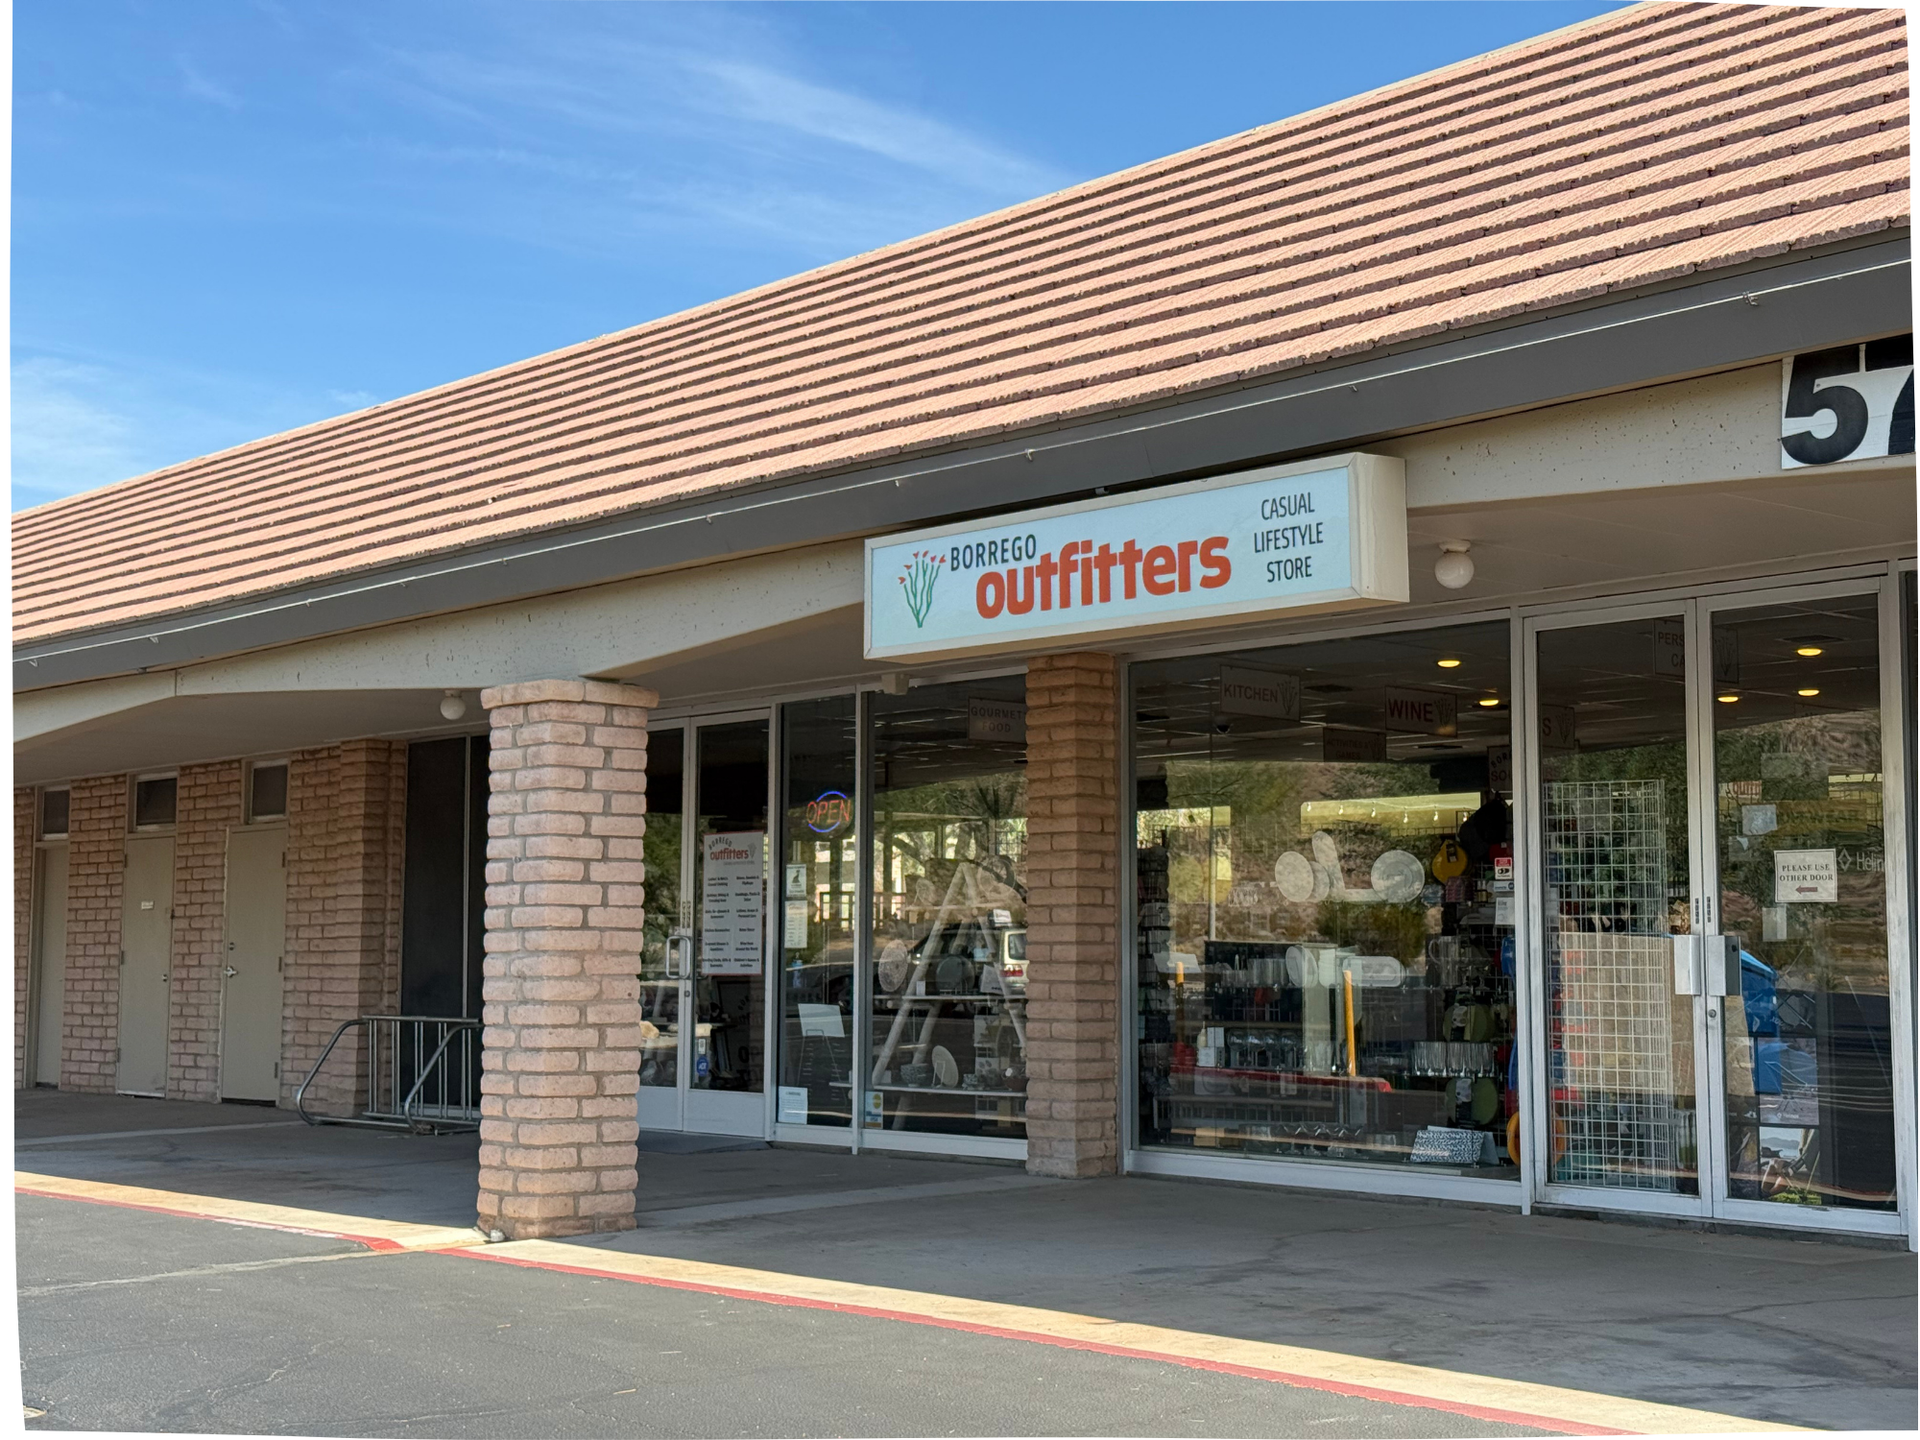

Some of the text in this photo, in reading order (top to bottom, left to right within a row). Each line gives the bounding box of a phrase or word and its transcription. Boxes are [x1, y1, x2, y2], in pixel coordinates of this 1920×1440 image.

[1261, 492, 1316, 521] CASUAL
[1253, 522, 1324, 553] LIFESTYLE
[949, 534, 1037, 571] BORREGO
[975, 536, 1232, 619] outfitters
[1266, 556, 1313, 582] STORE
[1658, 632, 1685, 647] PERS
[1224, 684, 1278, 703] KITCHEN
[971, 706, 1022, 720] GOURMET
[1388, 698, 1433, 722] WINE
[982, 721, 1011, 732] FOOD
[806, 799, 851, 824] OPEN
[710, 848, 749, 861] outfitters
[1779, 873, 1834, 882] OTHER DOOR
[1782, 863, 1830, 872] PLEASE USE
